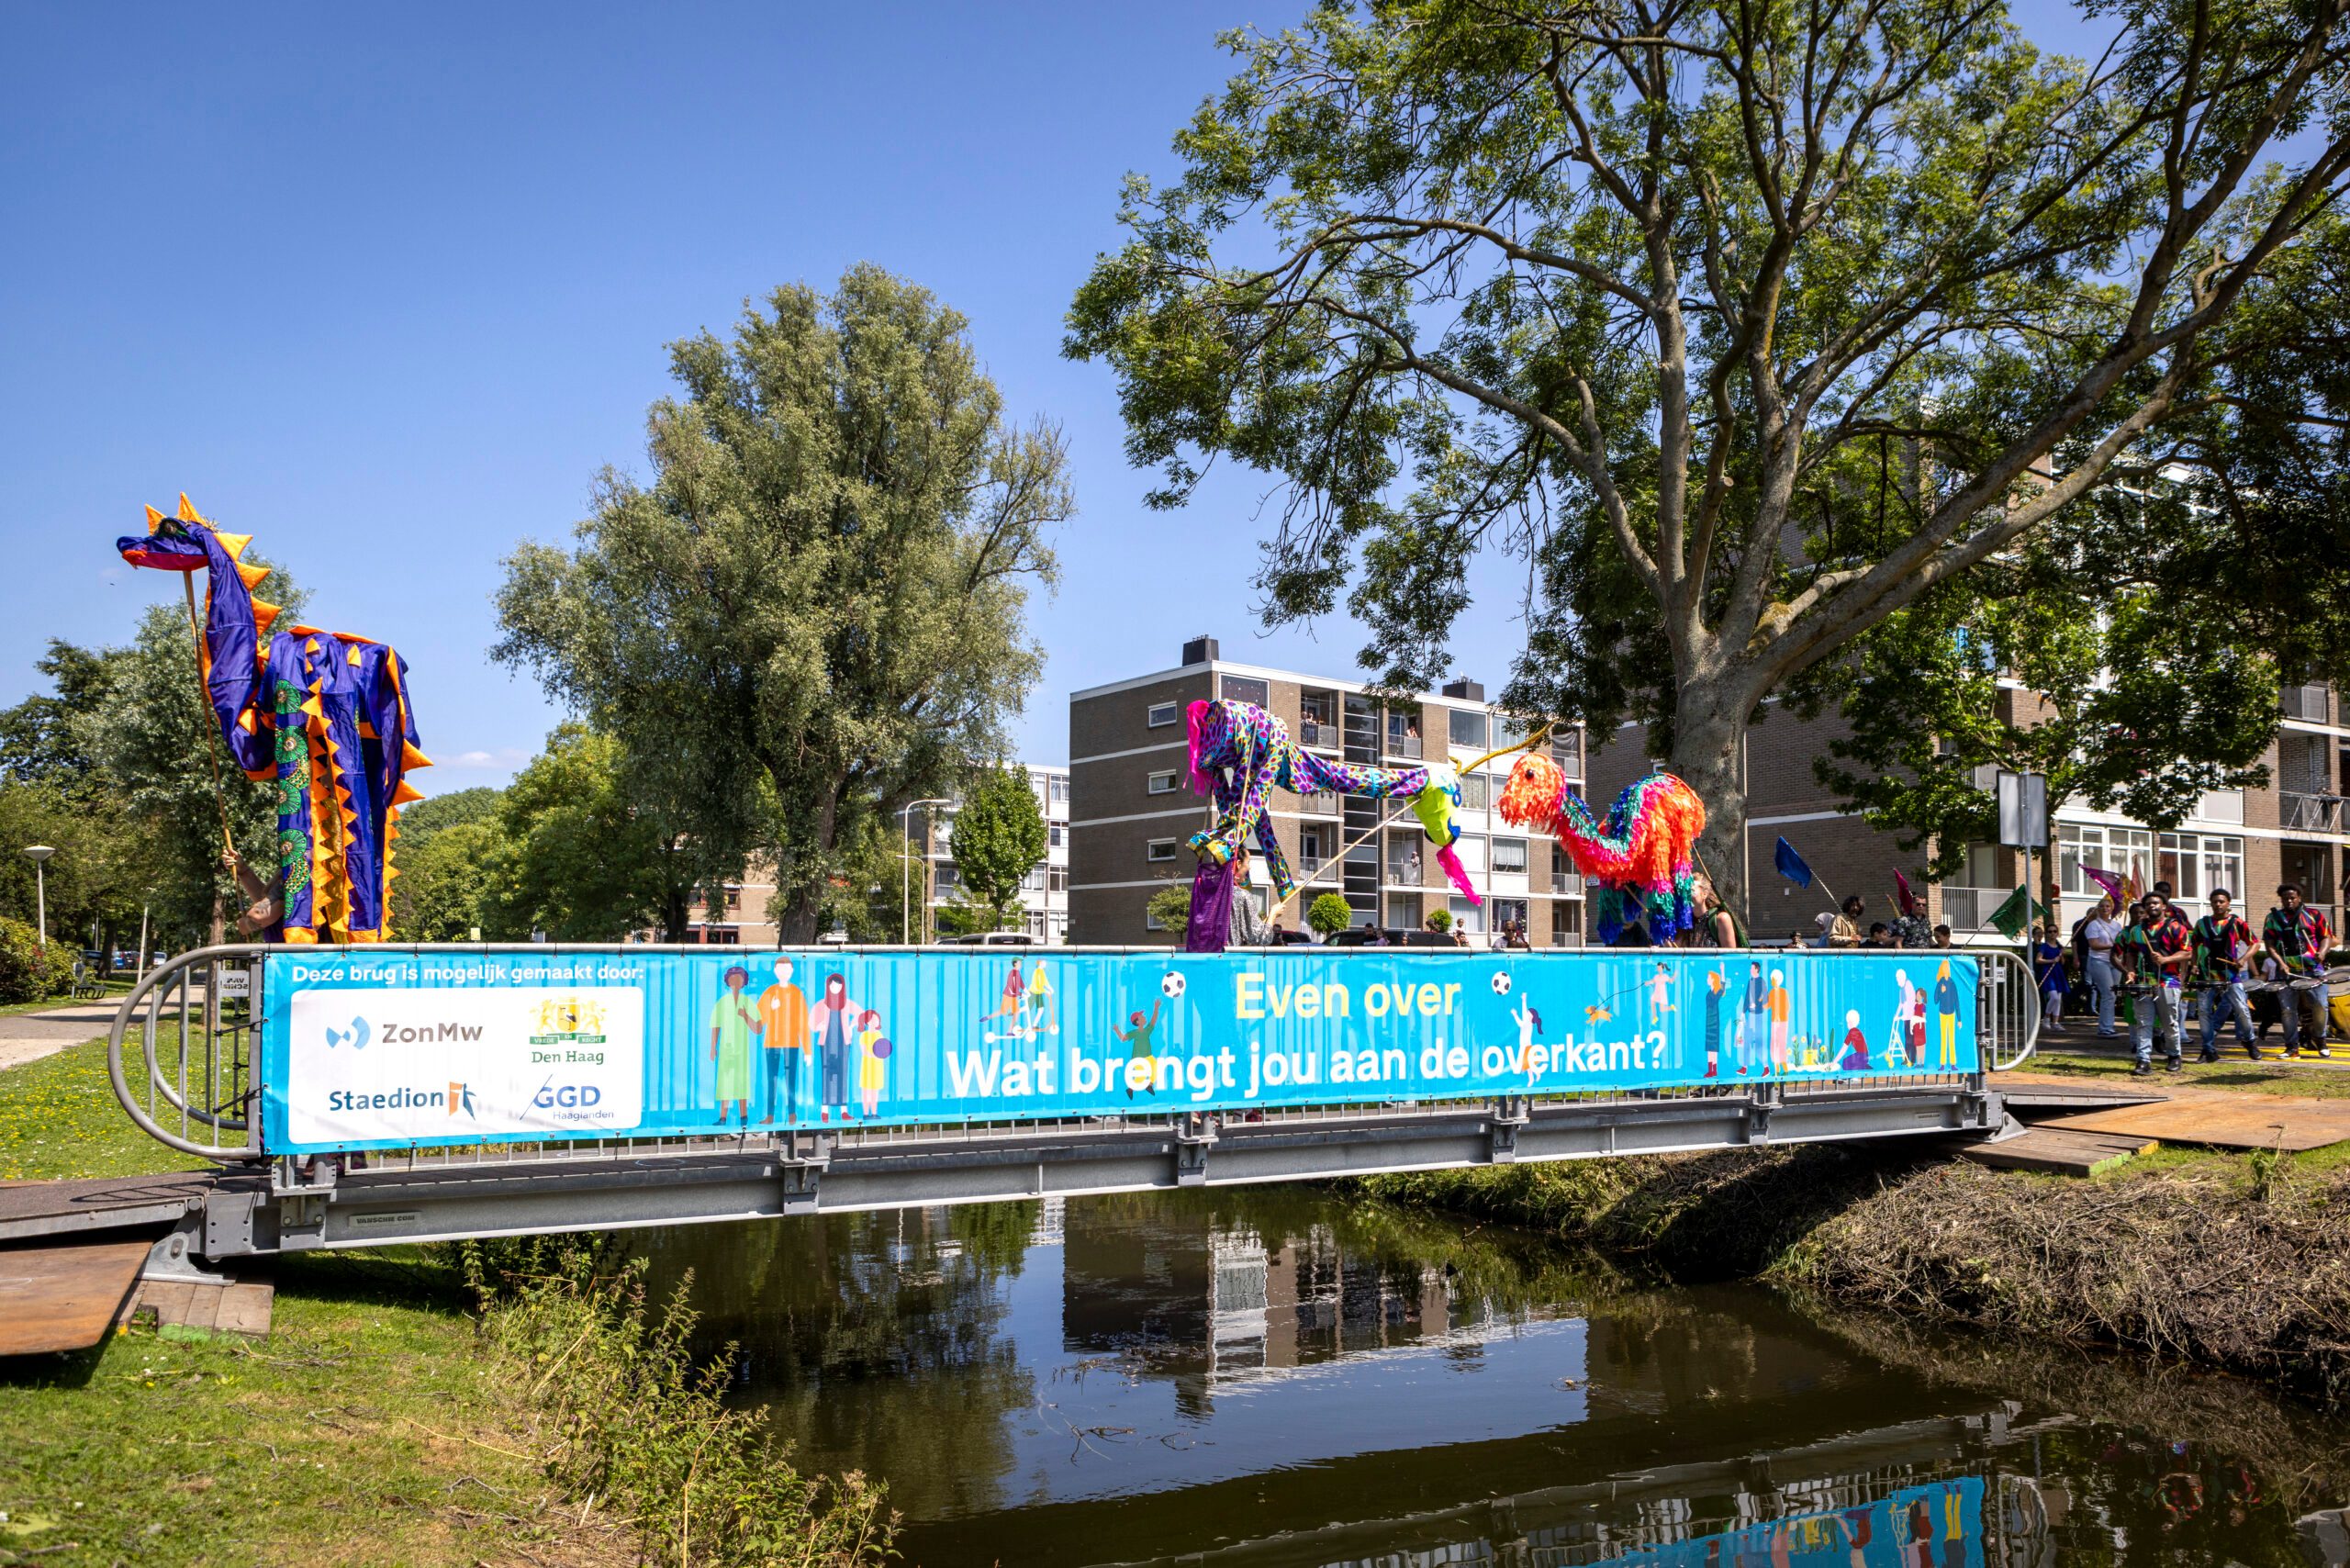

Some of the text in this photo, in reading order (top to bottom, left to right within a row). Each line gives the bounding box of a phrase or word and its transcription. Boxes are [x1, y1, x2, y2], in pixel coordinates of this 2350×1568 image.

[292, 964, 644, 983] Deze brug is mogelijk gemaakt door:
[1237, 972, 1460, 1019] Even over
[382, 1023, 483, 1044] ZonMw
[531, 1050, 604, 1066] Den Haag
[946, 1030, 1666, 1101] Wat brengt jou aan de overkant?
[329, 1088, 444, 1112] Staedion
[532, 1085, 601, 1108] GGD
[553, 1110, 614, 1121] Haaglanden
